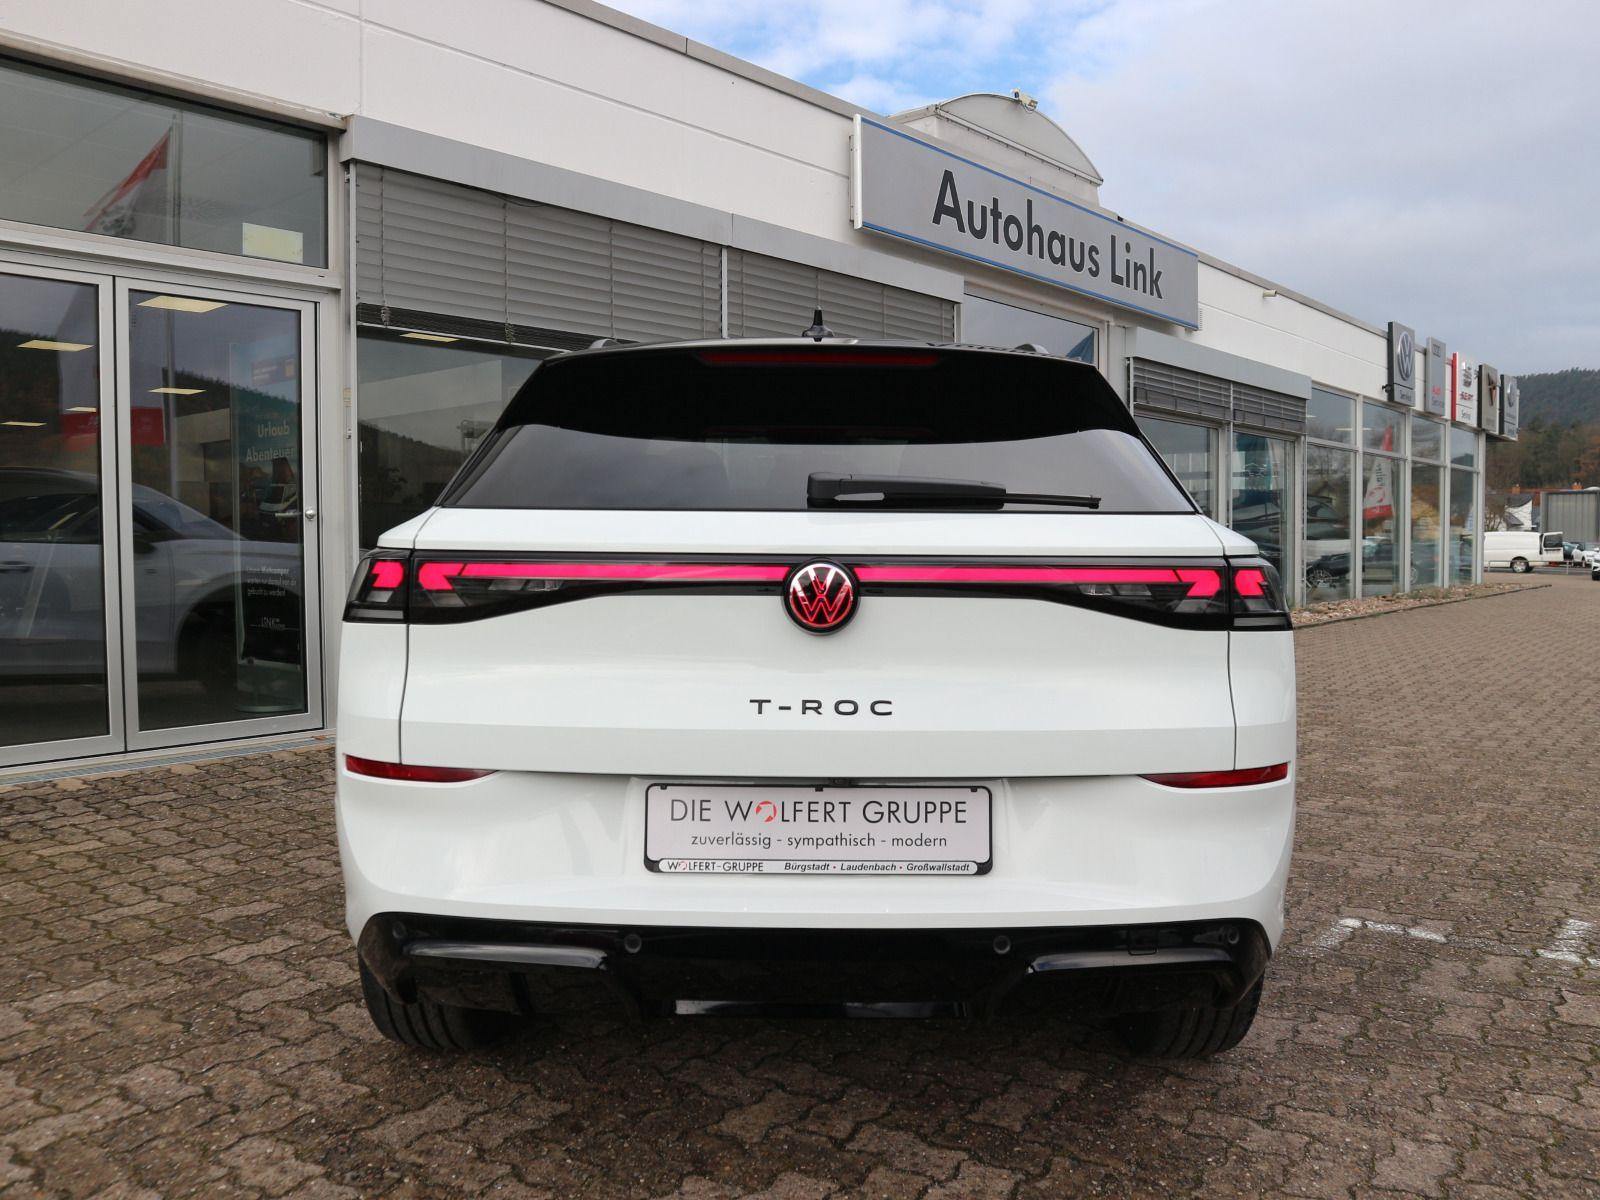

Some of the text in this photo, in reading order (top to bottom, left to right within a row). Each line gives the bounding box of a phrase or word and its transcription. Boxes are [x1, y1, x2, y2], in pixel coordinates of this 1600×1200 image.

[931, 169, 1163, 299] Autohaus Link
[257, 420, 290, 438] Urlaub
[749, 699, 893, 716] T-ROC
[670, 799, 967, 824] DIE WOLFERT GRUPPE
[691, 831, 771, 849] zuverlässig
[787, 833, 876, 849] sympathisch
[891, 833, 947, 847] modern
[784, 862, 830, 873] Bürgstadt
[840, 862, 897, 872] Laudenbach
[906, 863, 970, 873] Großwallstadt
